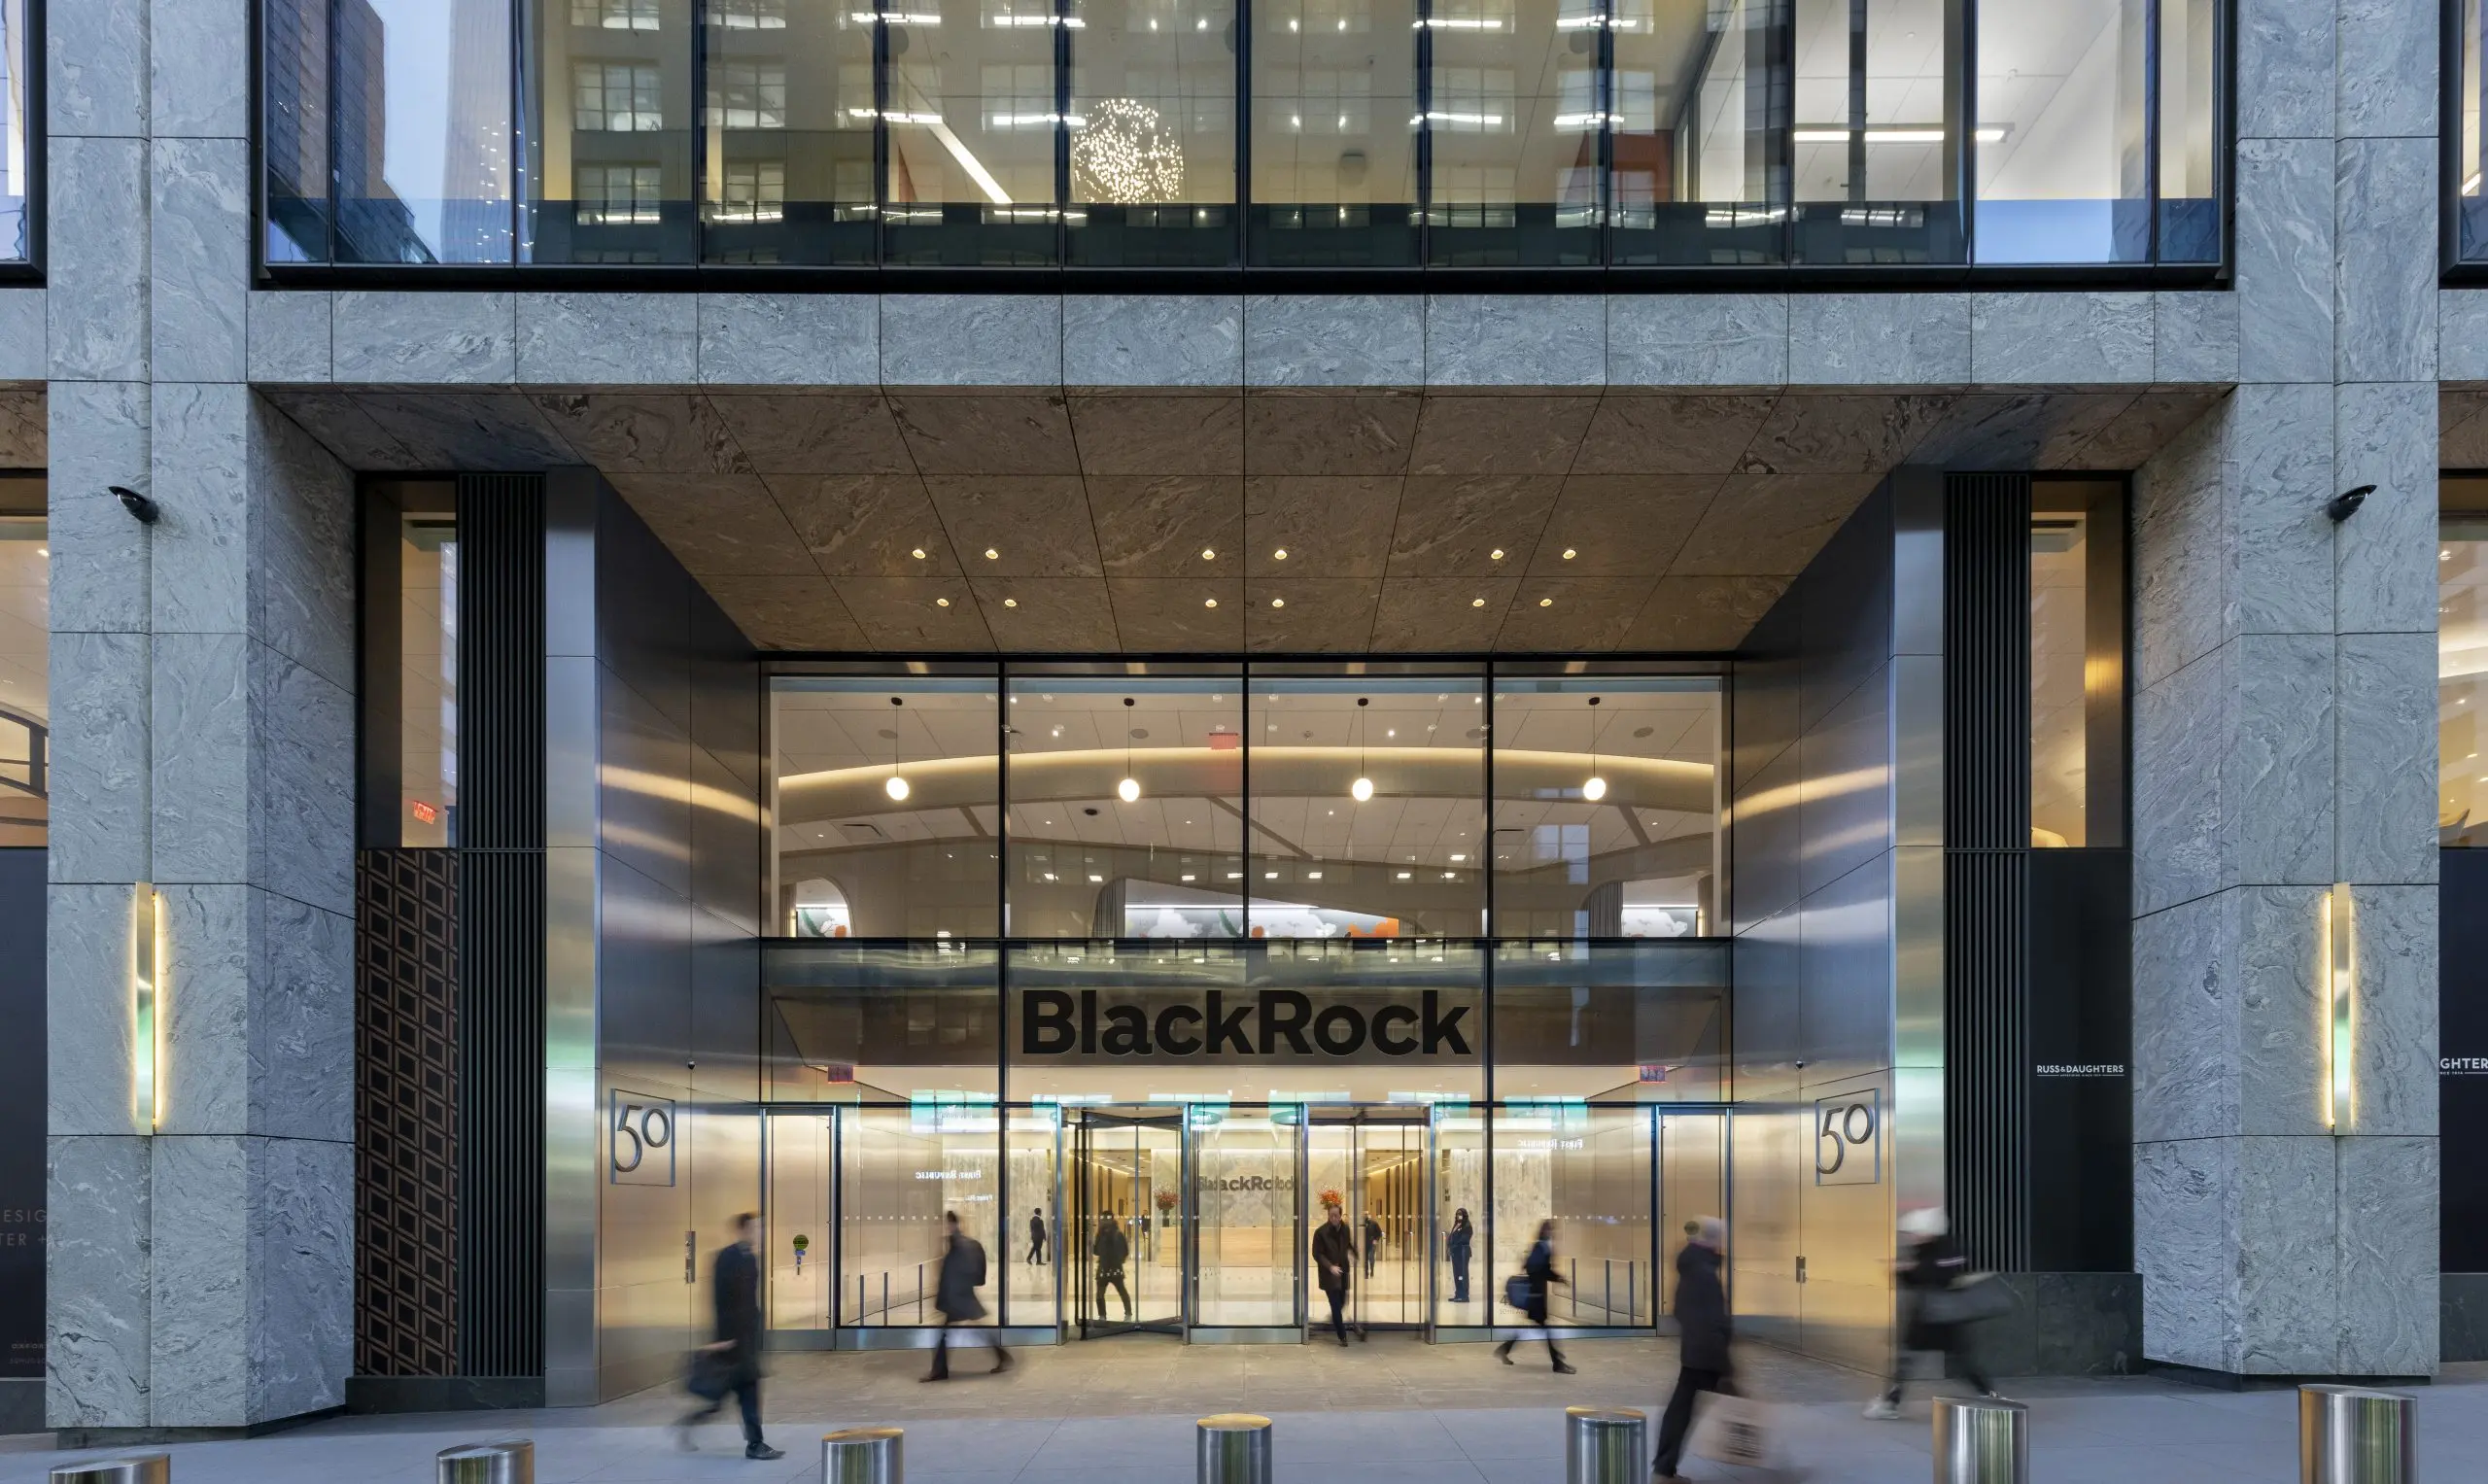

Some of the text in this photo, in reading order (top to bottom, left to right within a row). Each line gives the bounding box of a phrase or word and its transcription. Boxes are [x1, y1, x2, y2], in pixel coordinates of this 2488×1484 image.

[1021, 989, 1472, 1056] BlackRock
[613, 1104, 671, 1173] 50
[1816, 1103, 1875, 1174] 50
